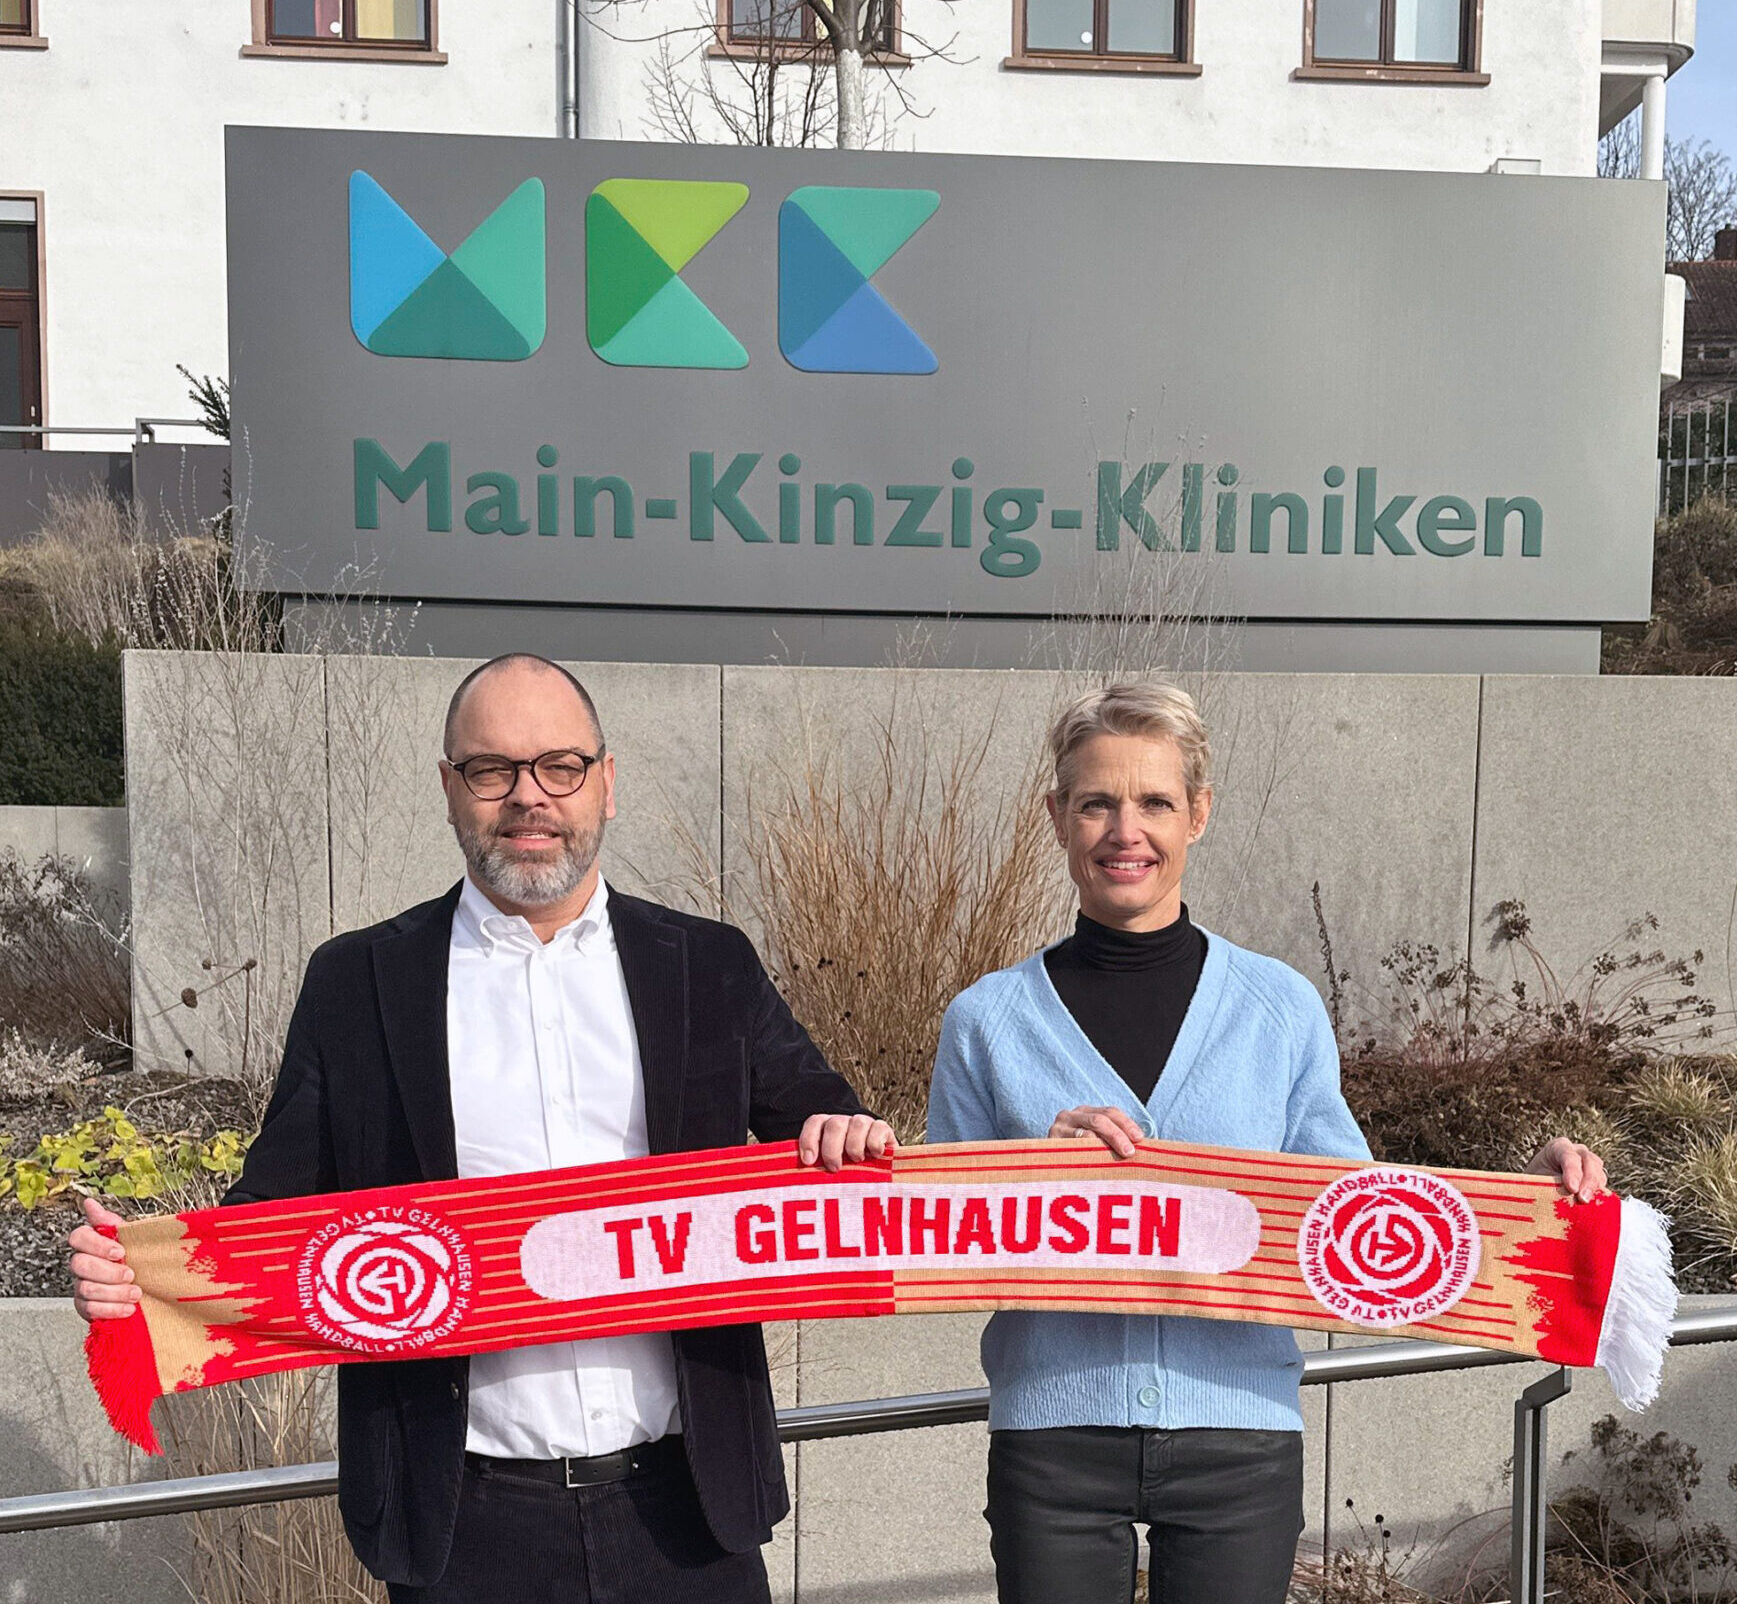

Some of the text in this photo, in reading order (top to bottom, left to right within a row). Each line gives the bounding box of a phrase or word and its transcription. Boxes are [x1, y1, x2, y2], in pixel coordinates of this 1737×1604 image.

[353, 437, 1543, 578] Main-Kinzig-Kliniken
[1316, 1172, 1398, 1218] HANDBALL
[341, 1212, 367, 1229] TV
[377, 1206, 404, 1218] TV
[604, 1194, 1182, 1280] TV GELNHAUSEN
[1351, 1304, 1376, 1320] TV
[1386, 1306, 1411, 1320] TV
[304, 1313, 385, 1353] HANDBALL
